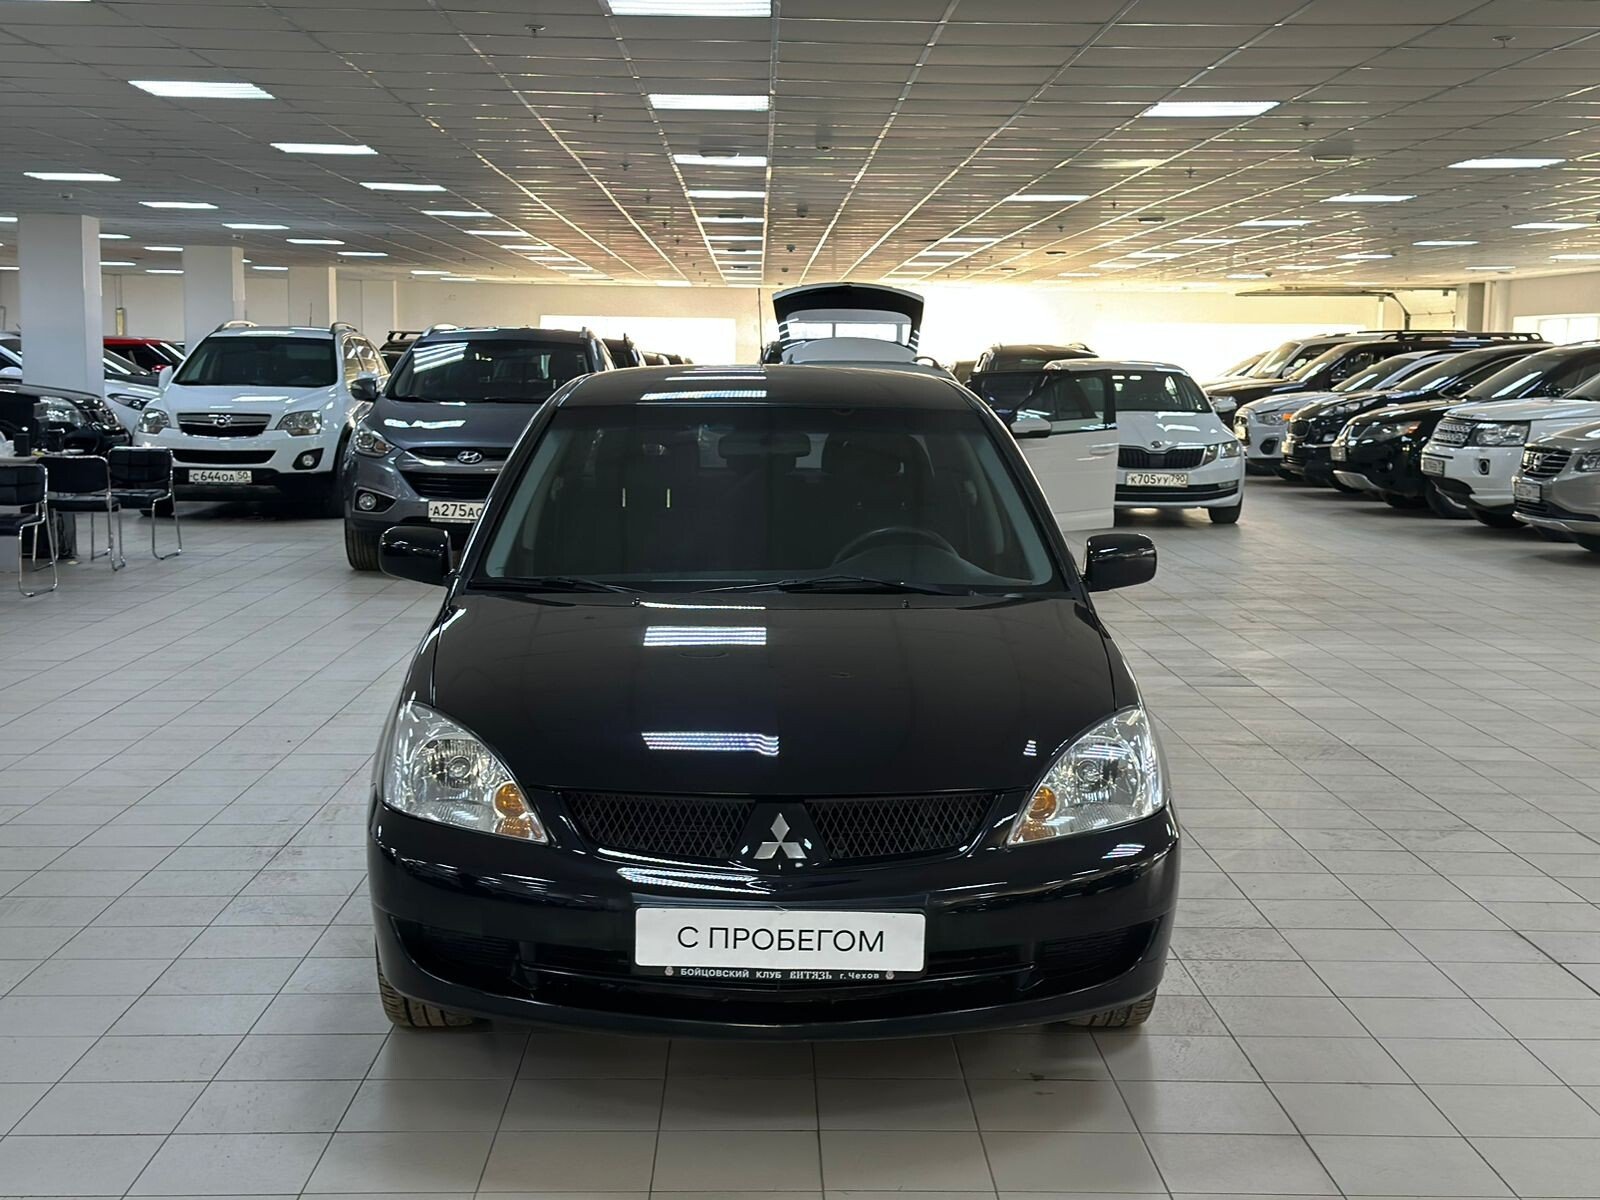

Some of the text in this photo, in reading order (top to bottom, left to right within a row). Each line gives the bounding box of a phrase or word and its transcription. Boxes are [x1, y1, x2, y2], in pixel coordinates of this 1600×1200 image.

[677, 926, 884, 952] С ПРОБЕГОМ
[680, 967, 749, 978] БОЙЦОВСКИЙ
[755, 970, 782, 979] КЛУБ
[789, 970, 832, 980] ВИТЯЗЬ
